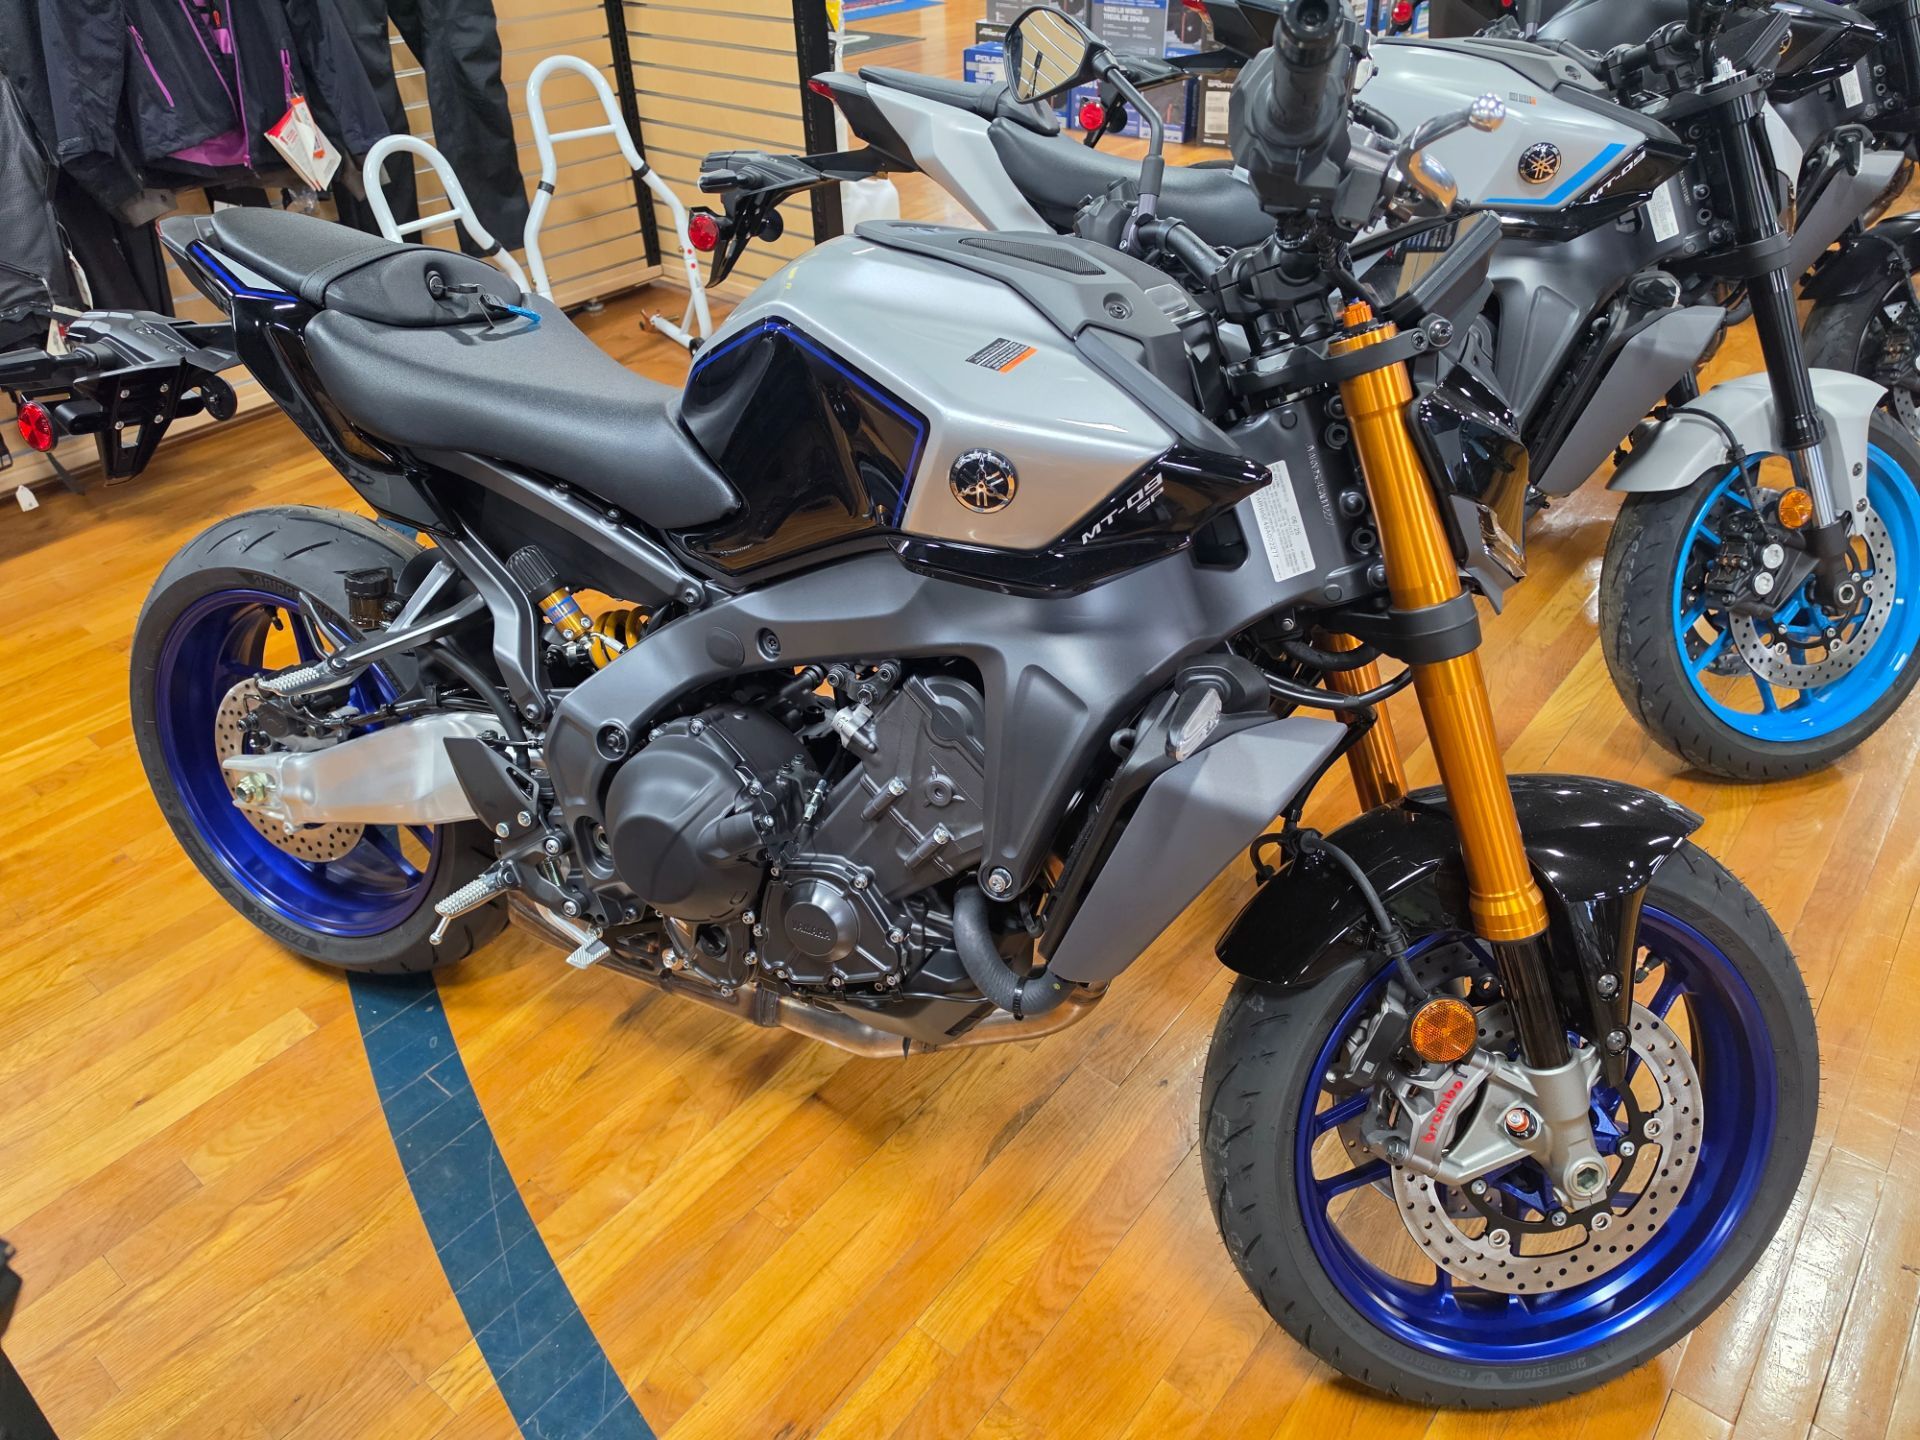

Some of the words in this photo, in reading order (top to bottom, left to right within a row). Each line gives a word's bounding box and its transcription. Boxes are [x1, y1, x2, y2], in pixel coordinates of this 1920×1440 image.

[1589, 150, 1646, 204] MT-09
[1081, 472, 1163, 545] MT-09
[1136, 486, 1165, 514] SP
[1422, 1080, 1464, 1144] brembo
